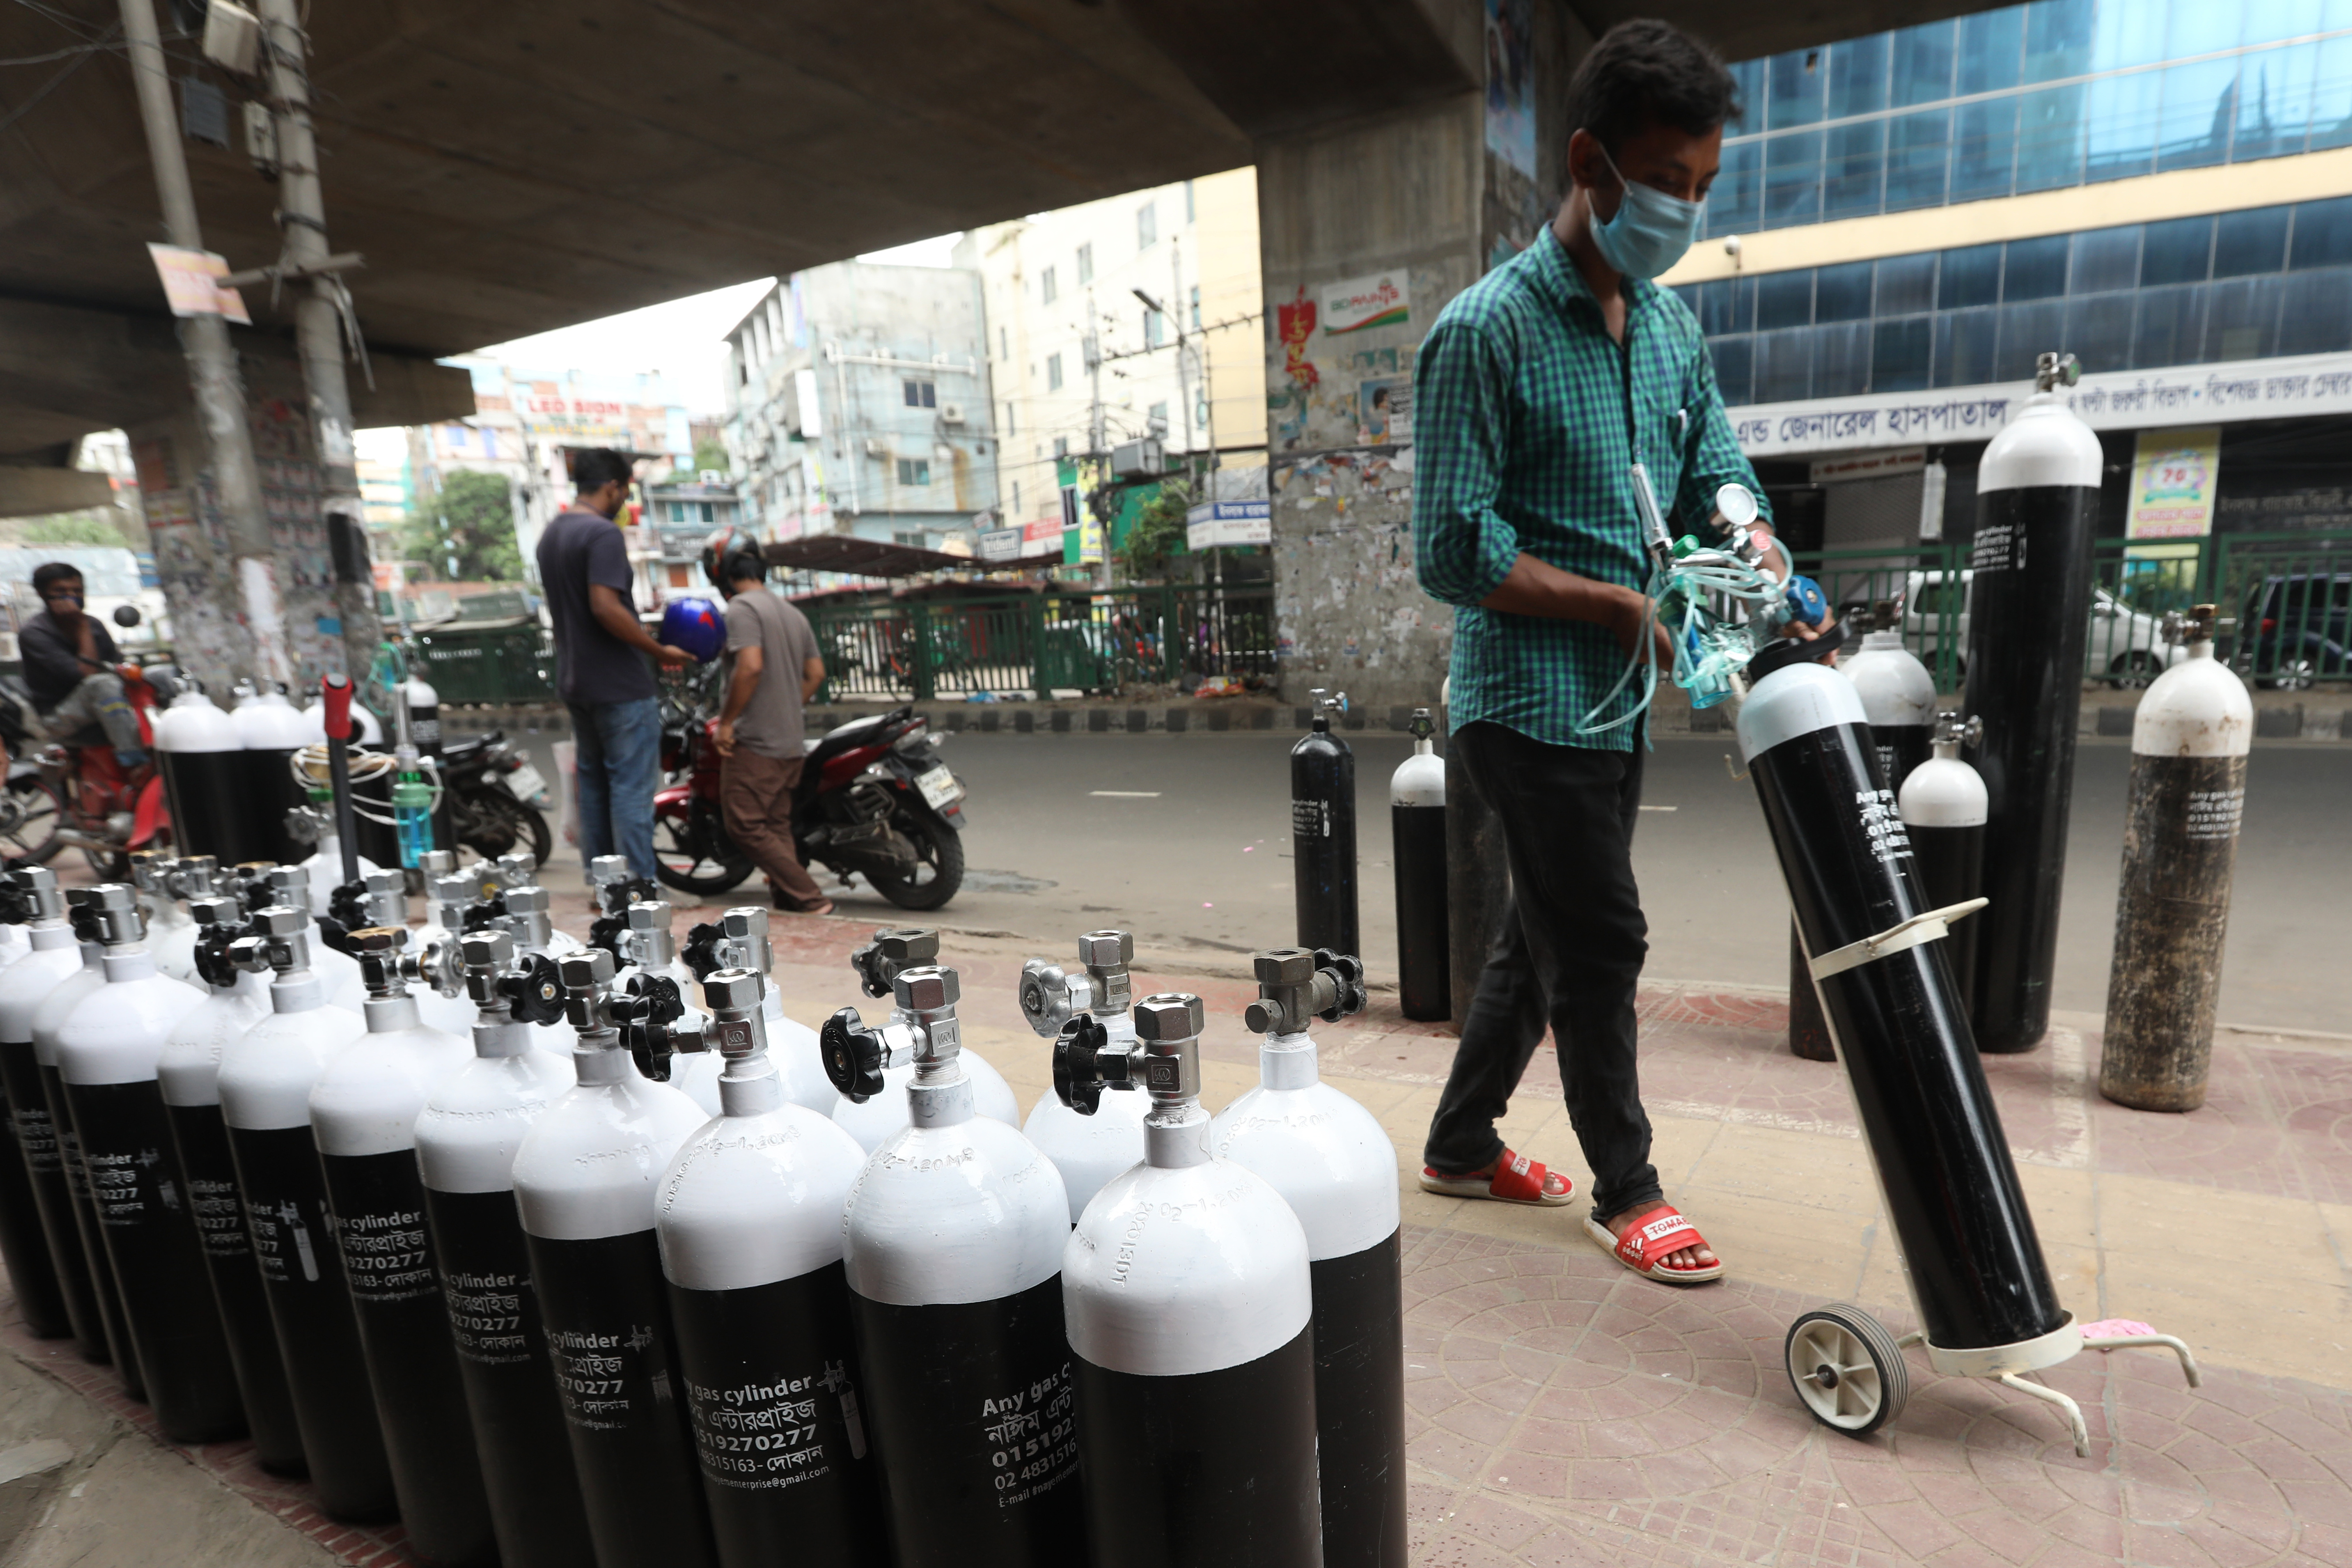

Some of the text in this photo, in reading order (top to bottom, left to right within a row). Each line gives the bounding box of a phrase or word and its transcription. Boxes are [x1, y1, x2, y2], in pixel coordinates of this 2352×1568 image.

[1780, 408, 1879, 443] জেনারেল
[1887, 395, 2012, 436] হাসপাতাল
[350, 1211, 421, 1233] cylinder
[450, 1273, 516, 1289] cylinder
[552, 1331, 619, 1349] cylinder
[695, 1385, 720, 1401] gas
[724, 1375, 812, 1406] cylinder
[982, 1391, 1025, 1417] Any
[1031, 1373, 1058, 1403] gas
[708, 1398, 817, 1432] এন্টারপ্রাইজ
[992, 1417, 1074, 1467] 015192
[767, 1445, 823, 1471] দোকান
[994, 1437, 1077, 1490] 02 4831516
[998, 1488, 1030, 1508] E-mail
